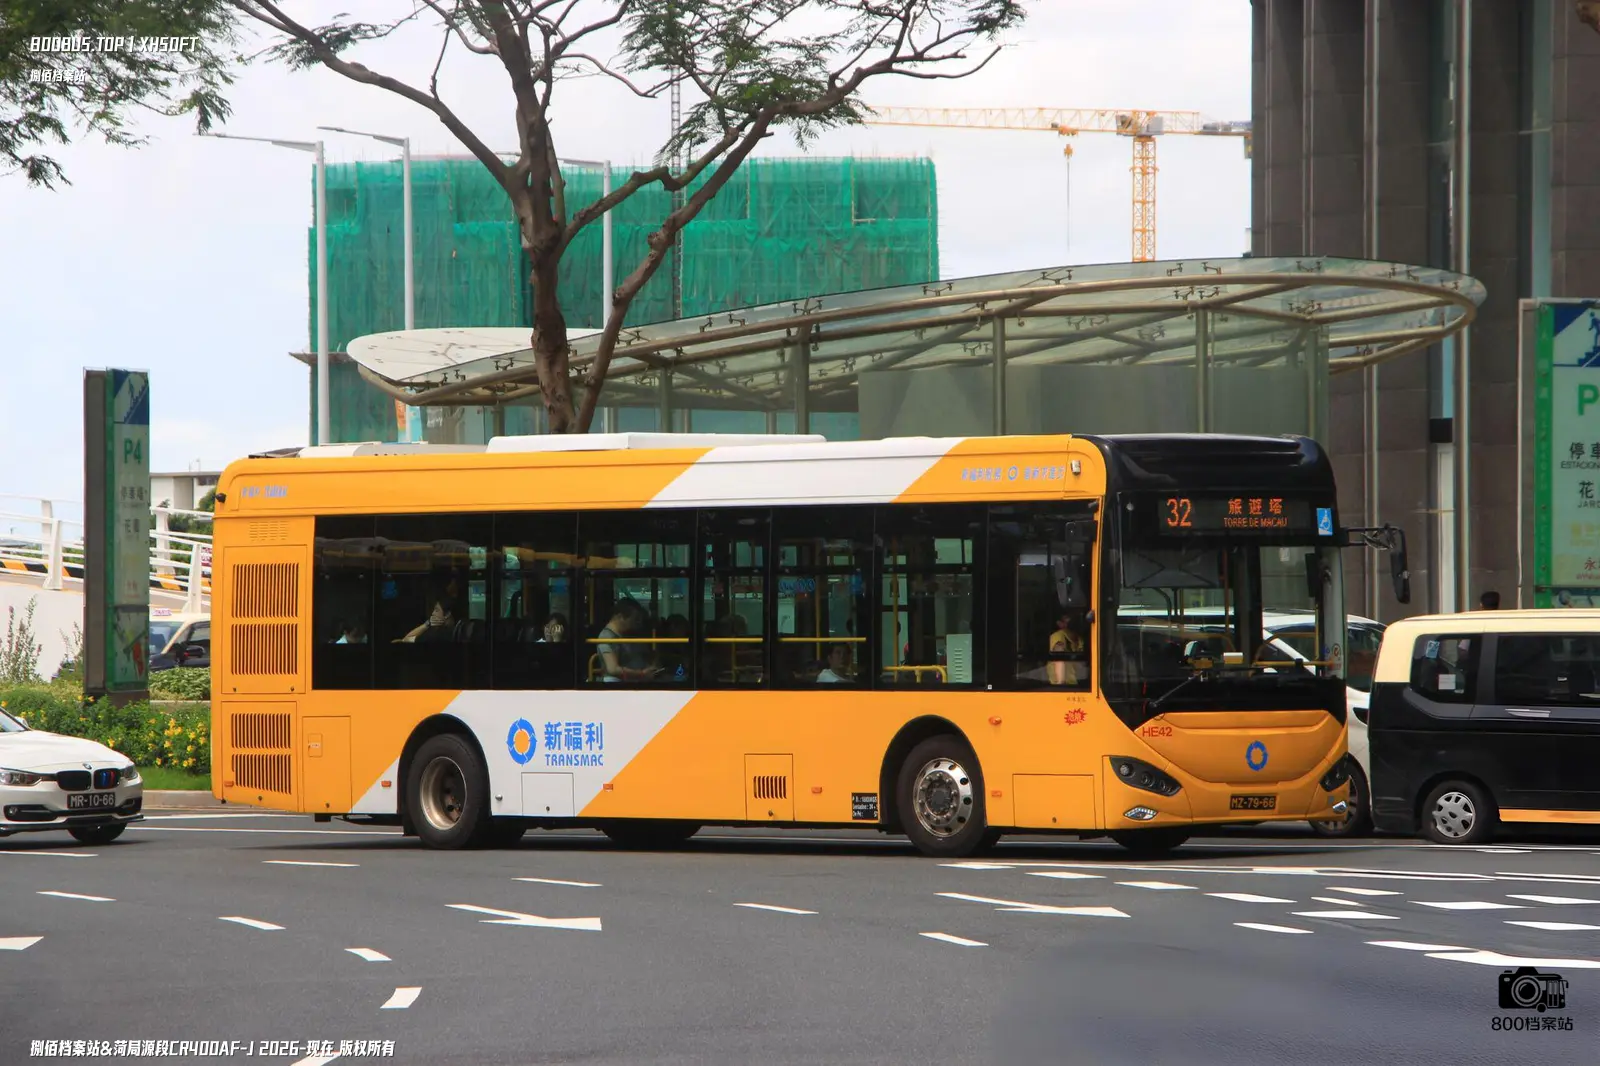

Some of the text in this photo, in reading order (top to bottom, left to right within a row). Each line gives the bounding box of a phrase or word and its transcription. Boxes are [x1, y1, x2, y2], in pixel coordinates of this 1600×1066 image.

[123, 438, 143, 465] P4
[1578, 479, 1600, 500] 花
[1166, 498, 1193, 528] 32
[1228, 498, 1283, 515] 旅遊塔
[1223, 517, 1288, 528] TORRE DE MACAU
[544, 721, 604, 751] 新福利
[1142, 726, 1173, 738] HE42
[544, 754, 604, 767] TRANSMAC
[70, 794, 115, 808] MR-10-66
